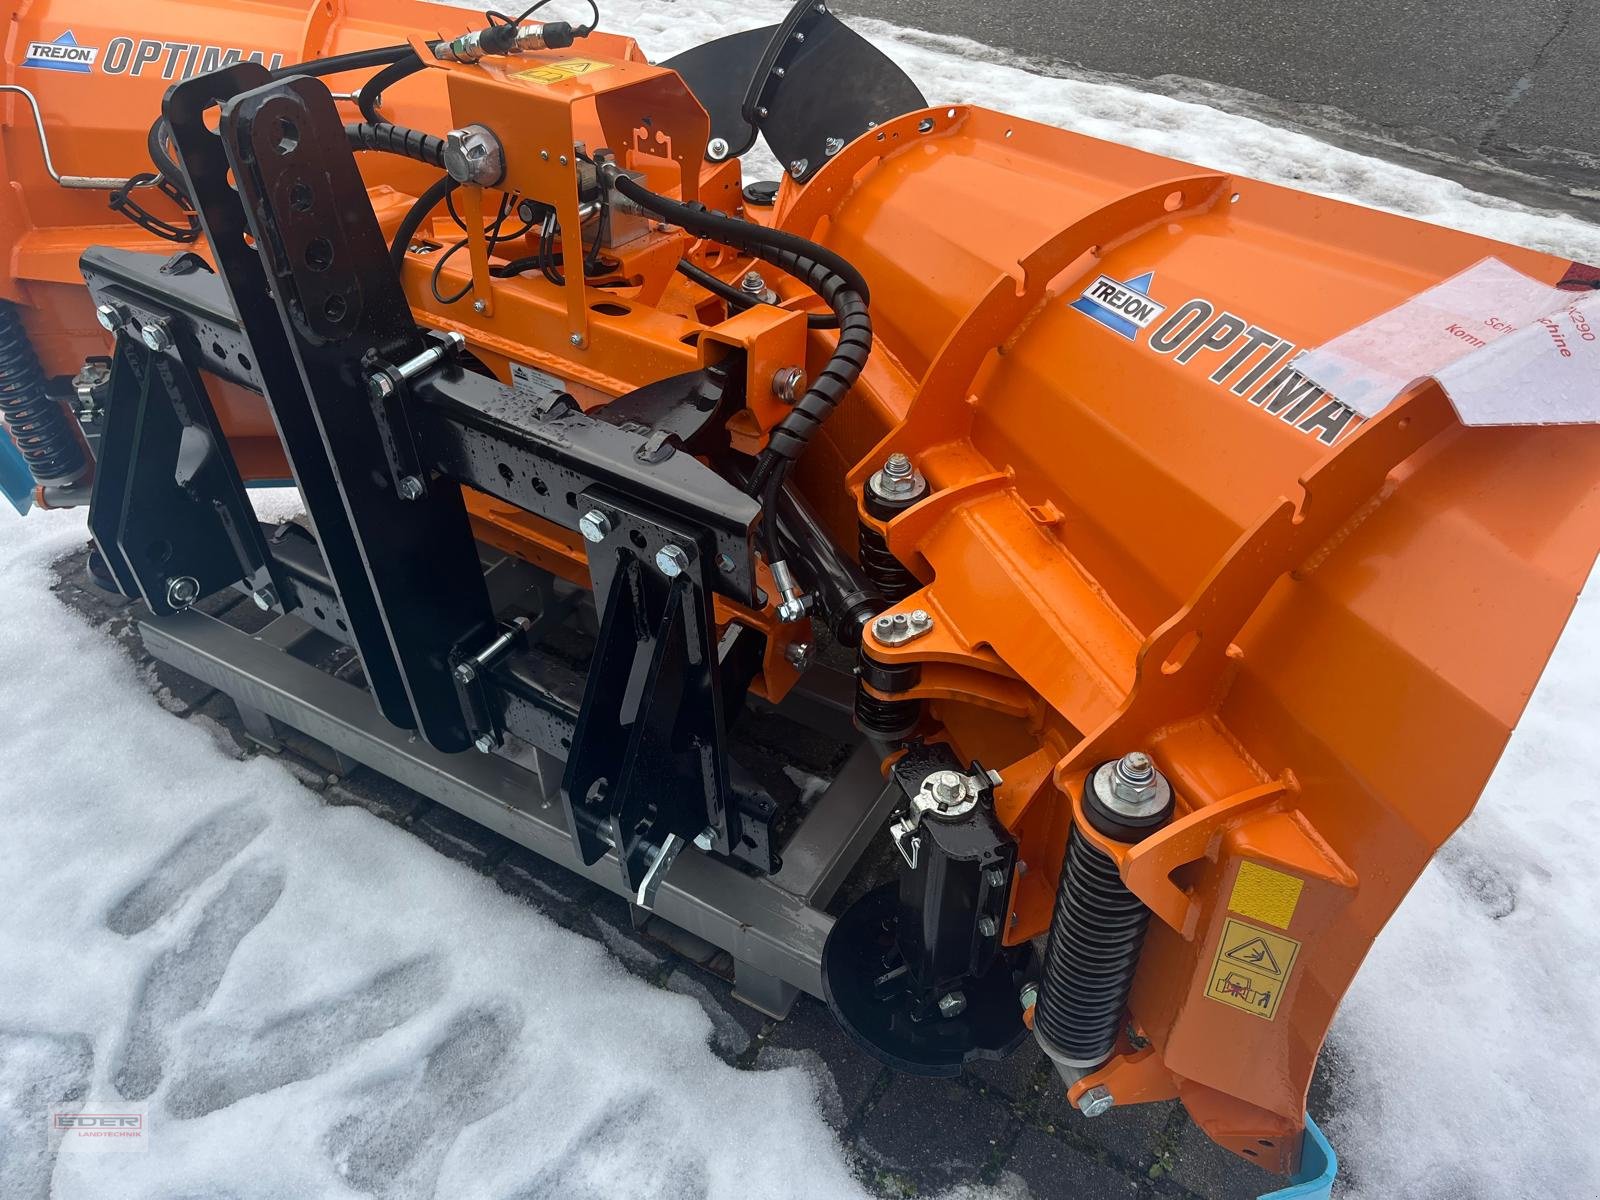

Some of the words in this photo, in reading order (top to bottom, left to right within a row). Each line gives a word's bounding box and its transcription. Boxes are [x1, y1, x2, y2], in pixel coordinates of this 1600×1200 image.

[31, 44, 92, 61] TREJON
[1090, 280, 1154, 322] TREJON
[1148, 298, 1360, 447] OPTIMA
